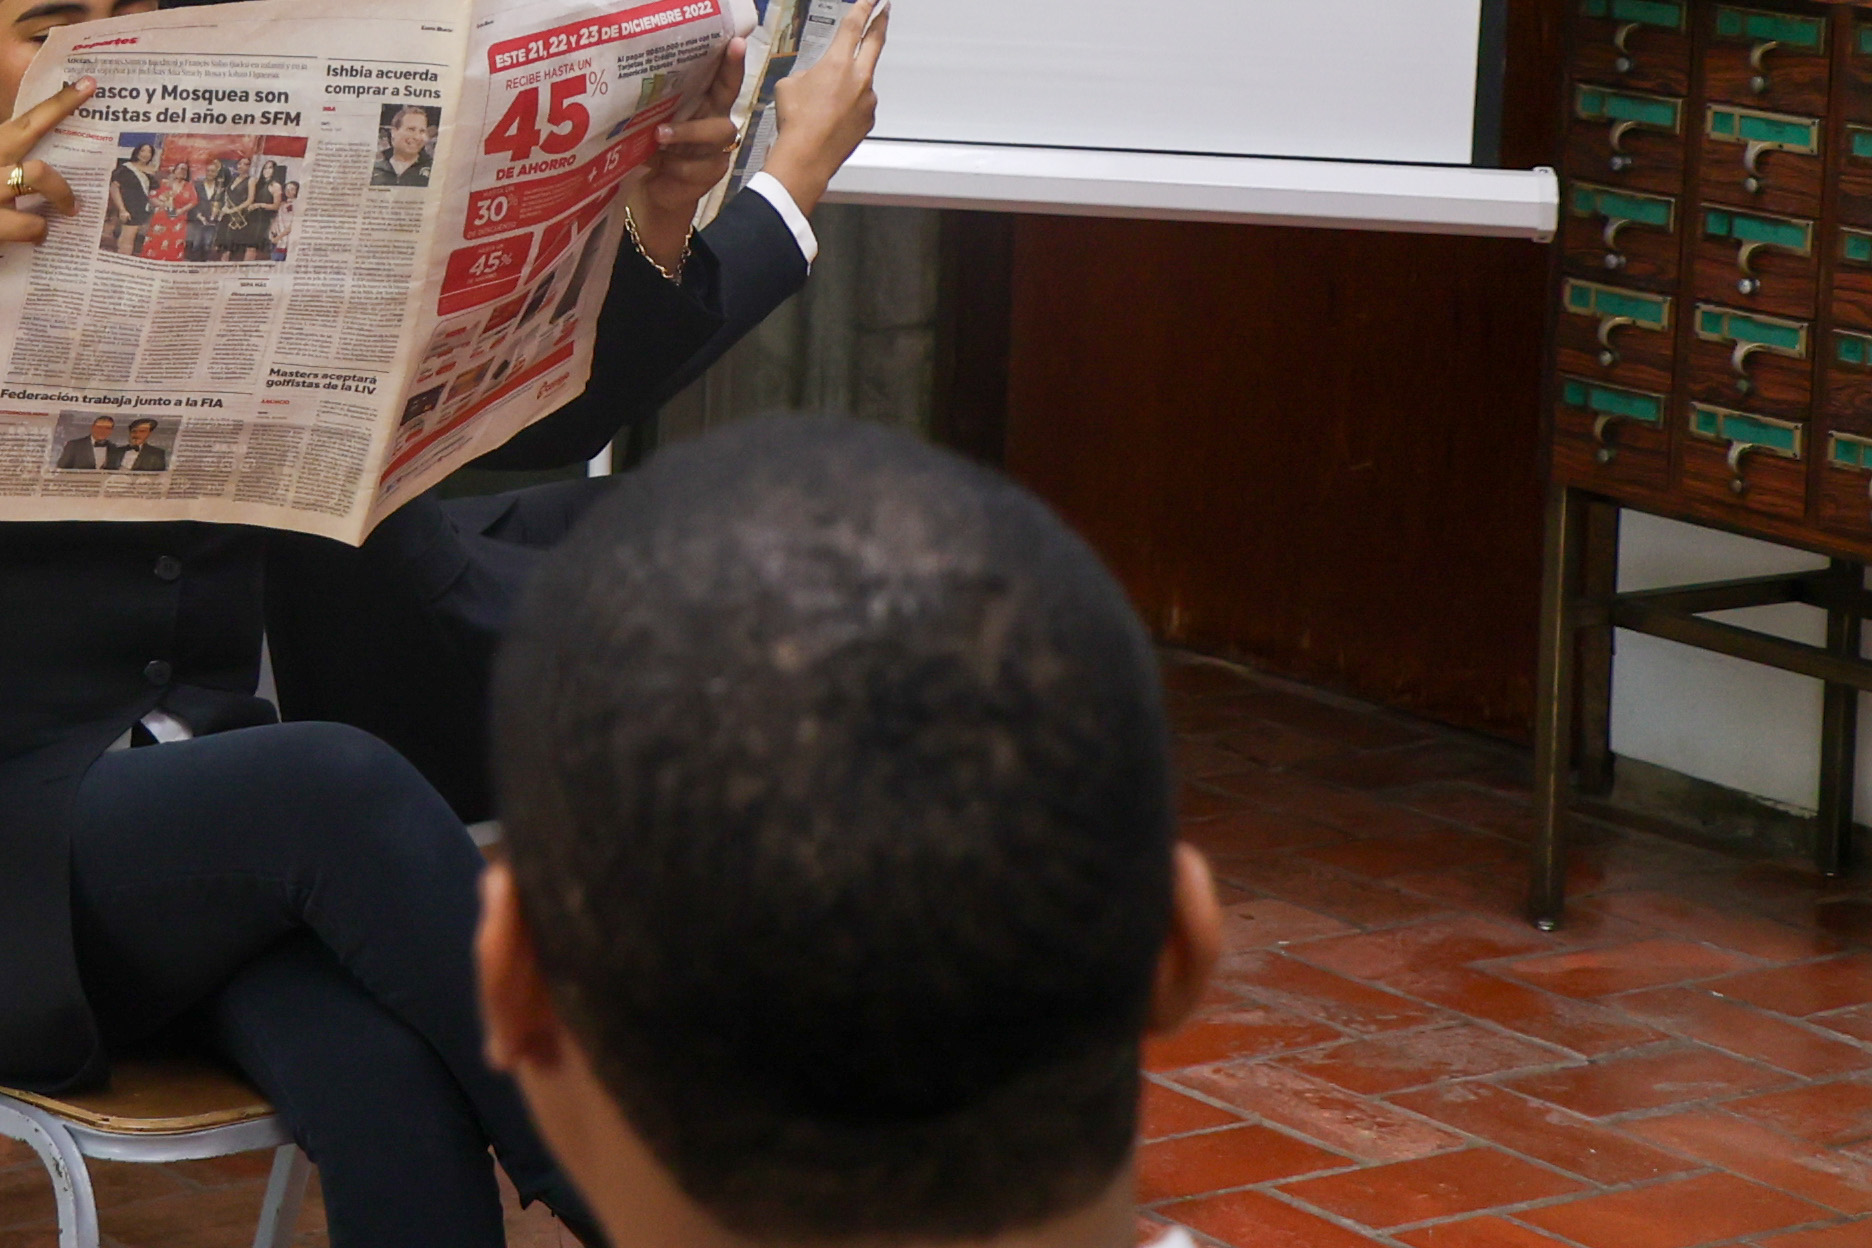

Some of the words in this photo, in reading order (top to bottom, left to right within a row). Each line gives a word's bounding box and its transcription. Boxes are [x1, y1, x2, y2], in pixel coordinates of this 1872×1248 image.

[495, 48, 526, 69] ESTE
[549, 34, 568, 53] 22
[569, 35, 577, 47] Y
[579, 25, 600, 45] 23
[601, 23, 619, 39] DE
[621, 8, 682, 36] DICIEMBRE
[683, 0, 713, 20] 2022
[327, 64, 372, 79] Ishbia
[375, 68, 438, 82] acuerda
[506, 71, 541, 90] RECIBE
[544, 63, 576, 80] HASTA
[579, 57, 592, 70] UN
[146, 87, 156, 103] y
[161, 84, 249, 104] Mosquea
[254, 89, 289, 104] son
[325, 82, 388, 98] comprar
[391, 88, 400, 96] a
[404, 85, 441, 99] Suns
[156, 106, 185, 123] del
[190, 108, 227, 125] año
[231, 112, 255, 125] en
[259, 110, 302, 127] SFM
[496, 166, 516, 181] DE
[516, 154, 577, 176] AHORRO
[469, 250, 512, 276] 45%
[269, 368, 318, 379] Masters
[321, 373, 377, 385] aceptará
[266, 379, 320, 388] golfistas
[323, 381, 338, 390] de
[341, 382, 351, 391] la
[354, 384, 376, 395] LIV
[0, 388, 79, 402] Federación
[82, 395, 132, 407] trabaja
[134, 396, 171, 407] junto
[173, 399, 183, 407] a
[185, 397, 198, 407] la
[200, 397, 224, 408] FIA
